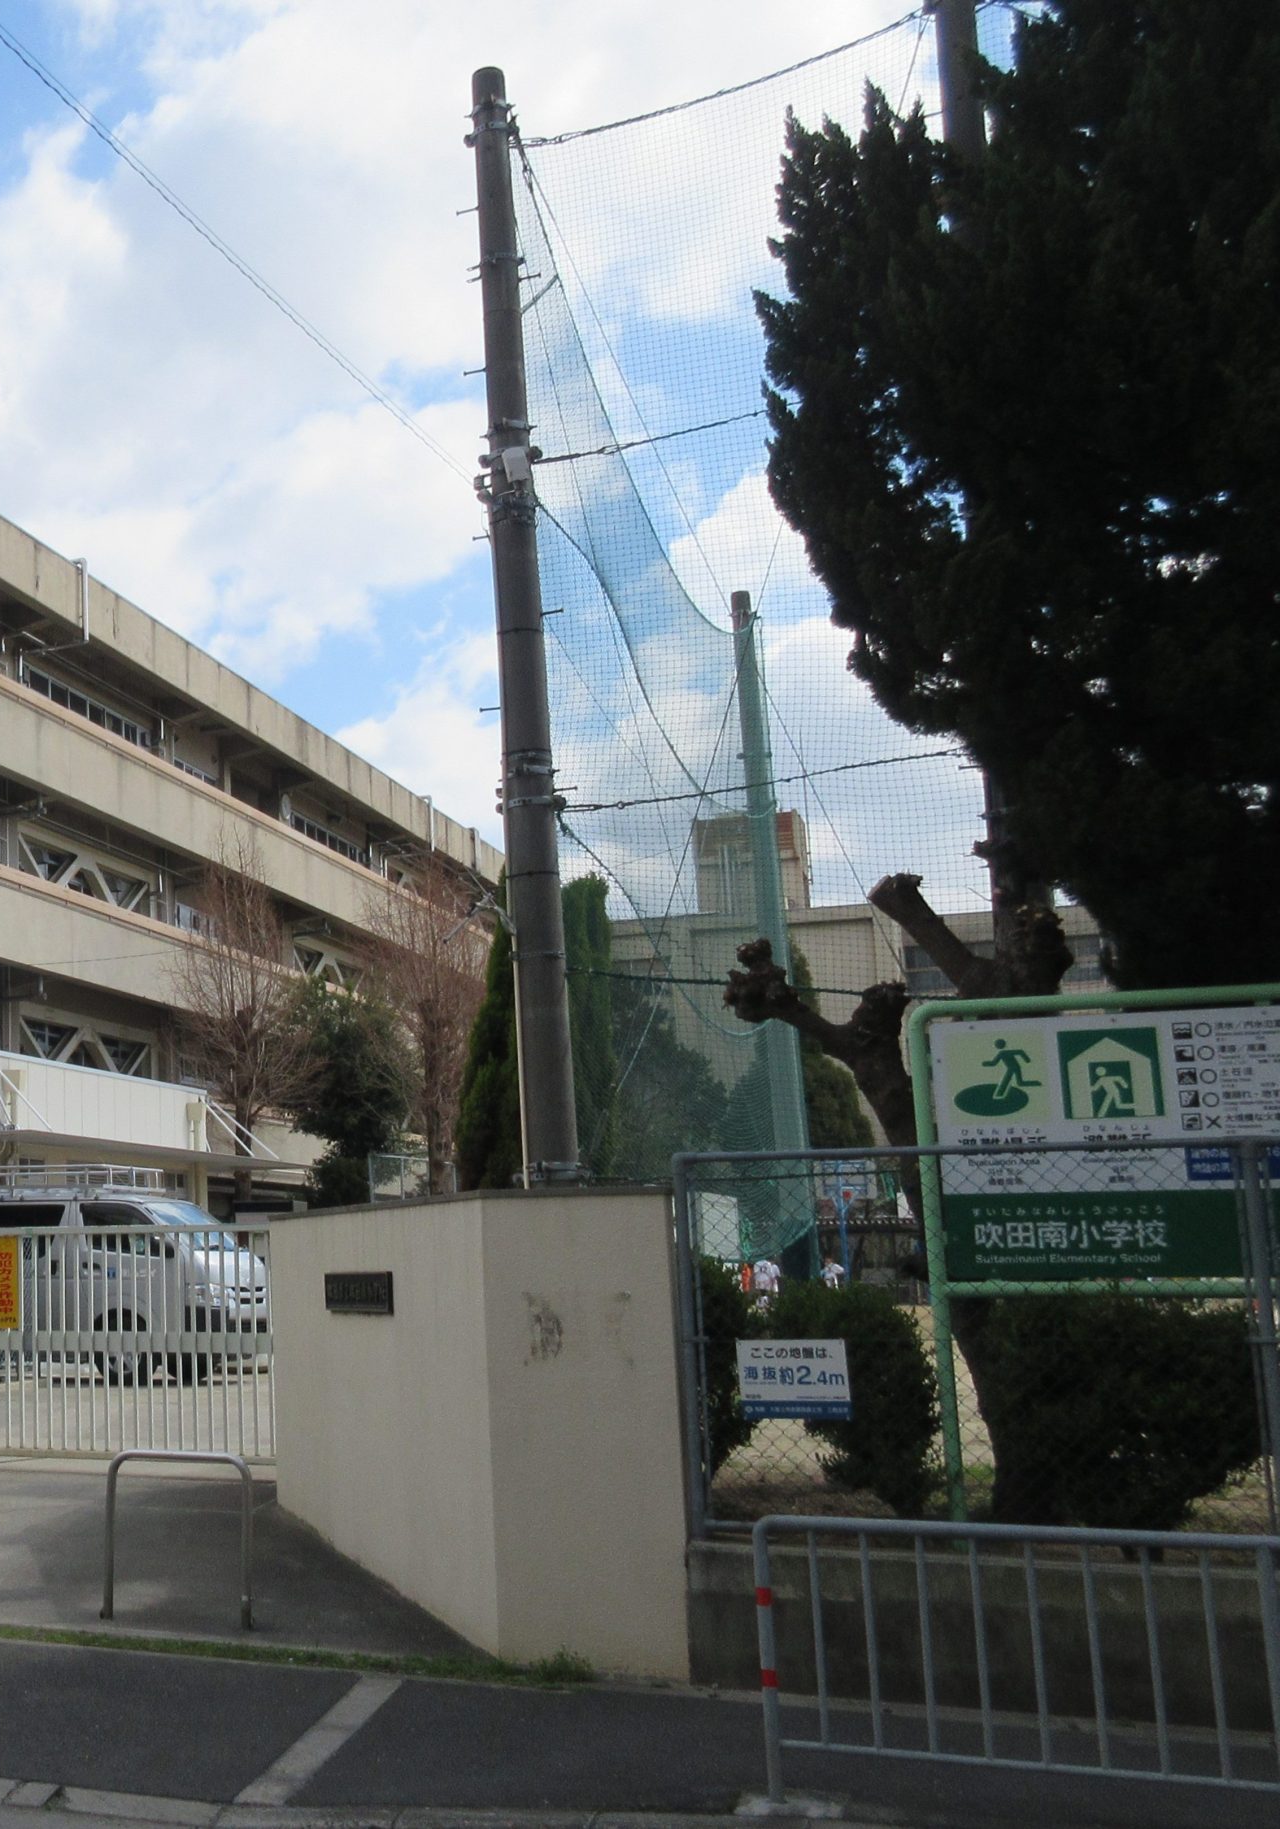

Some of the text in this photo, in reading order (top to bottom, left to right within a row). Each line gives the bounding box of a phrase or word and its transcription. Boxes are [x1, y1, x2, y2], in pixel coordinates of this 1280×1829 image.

[974, 1219, 1168, 1249] 吹田南小学校
[1049, 1253, 1116, 1264] Elementary
[1119, 1253, 1162, 1263] School
[750, 1347, 833, 1359] ここの地盤は、
